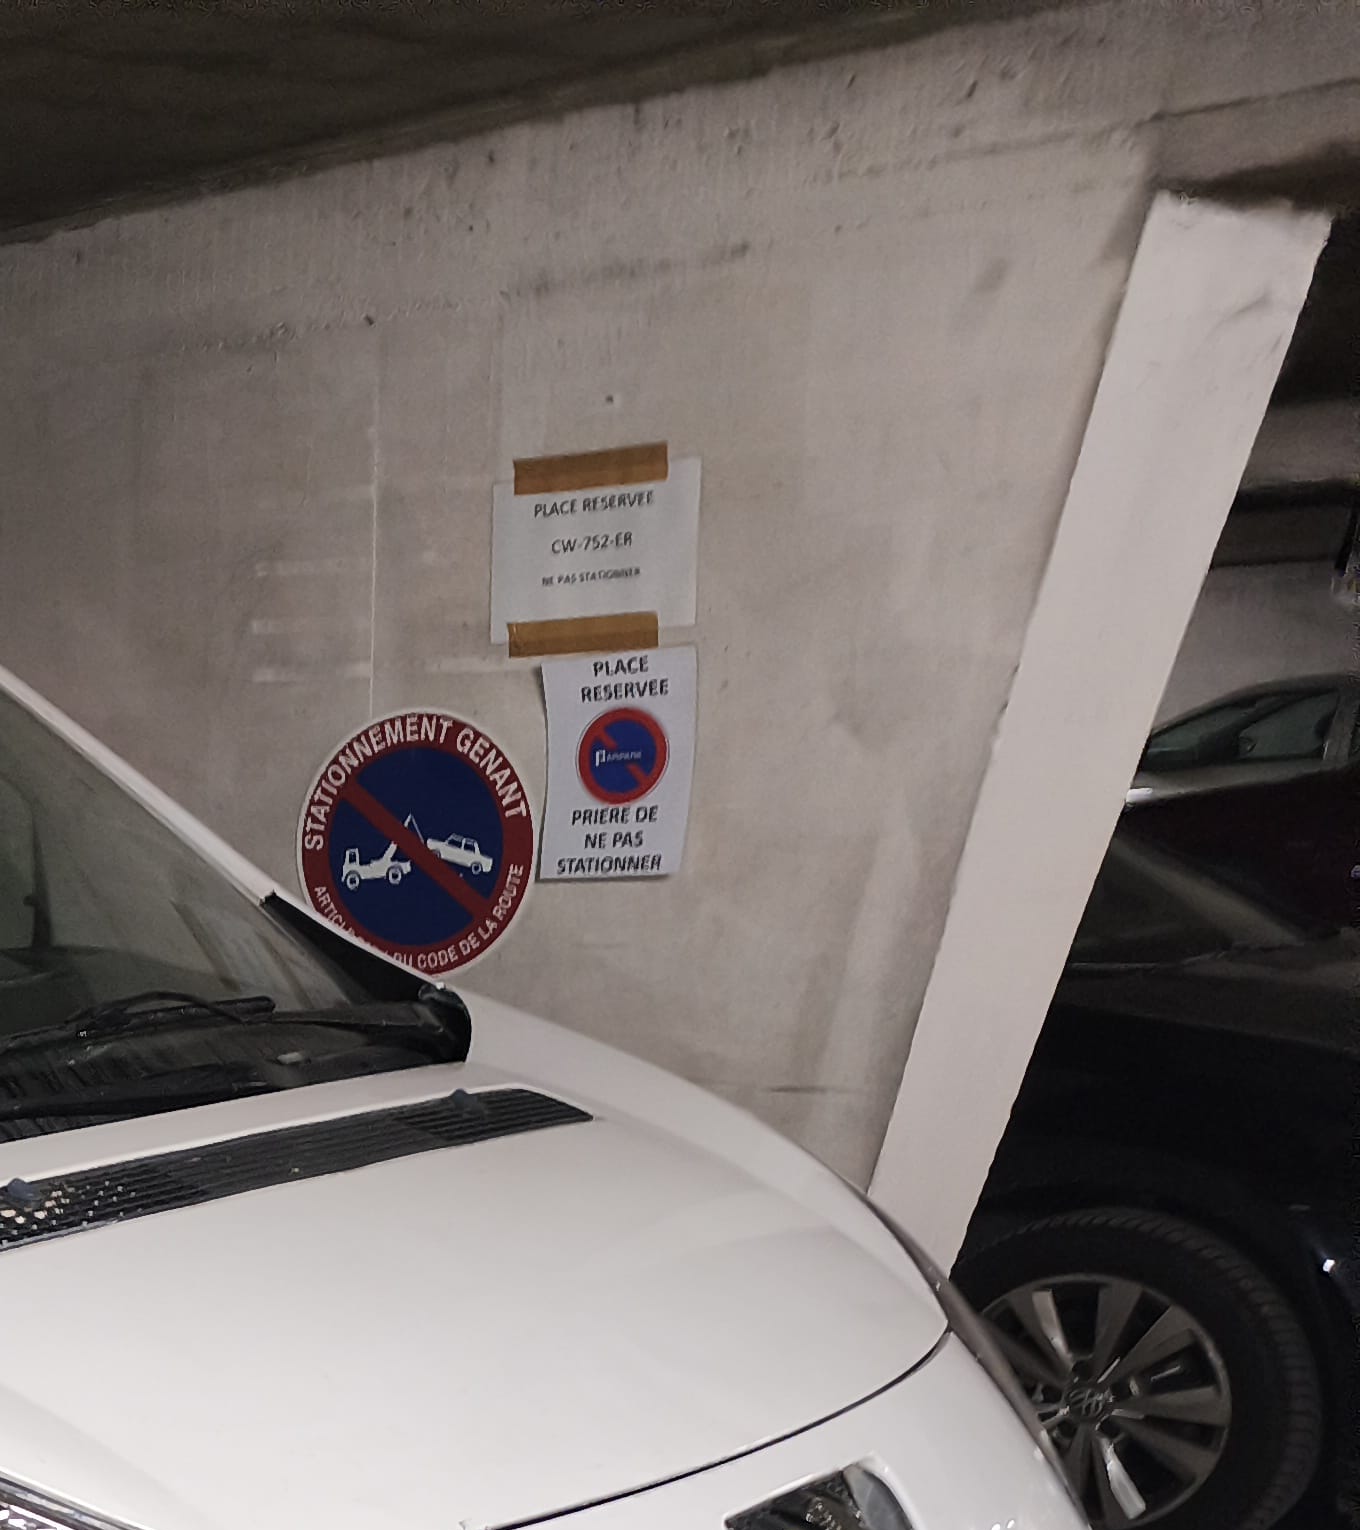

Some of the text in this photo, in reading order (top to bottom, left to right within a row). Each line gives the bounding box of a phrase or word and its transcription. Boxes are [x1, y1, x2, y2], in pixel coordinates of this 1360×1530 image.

[534, 490, 654, 518] PLACE RESERVEE
[551, 531, 633, 554] CW-752-ER
[593, 655, 649, 677] PLACE
[581, 678, 669, 703] RESERVEE
[305, 713, 527, 850] STATIONNEMENT GENANT
[572, 805, 659, 825] PRIERE DE
[584, 830, 644, 849] NE PAS
[556, 854, 662, 875] STATIONNER
[417, 945, 459, 969] CODE
[459, 933, 481, 956] DE
[480, 919, 498, 940] LA
[492, 863, 524, 921] ROUTE
